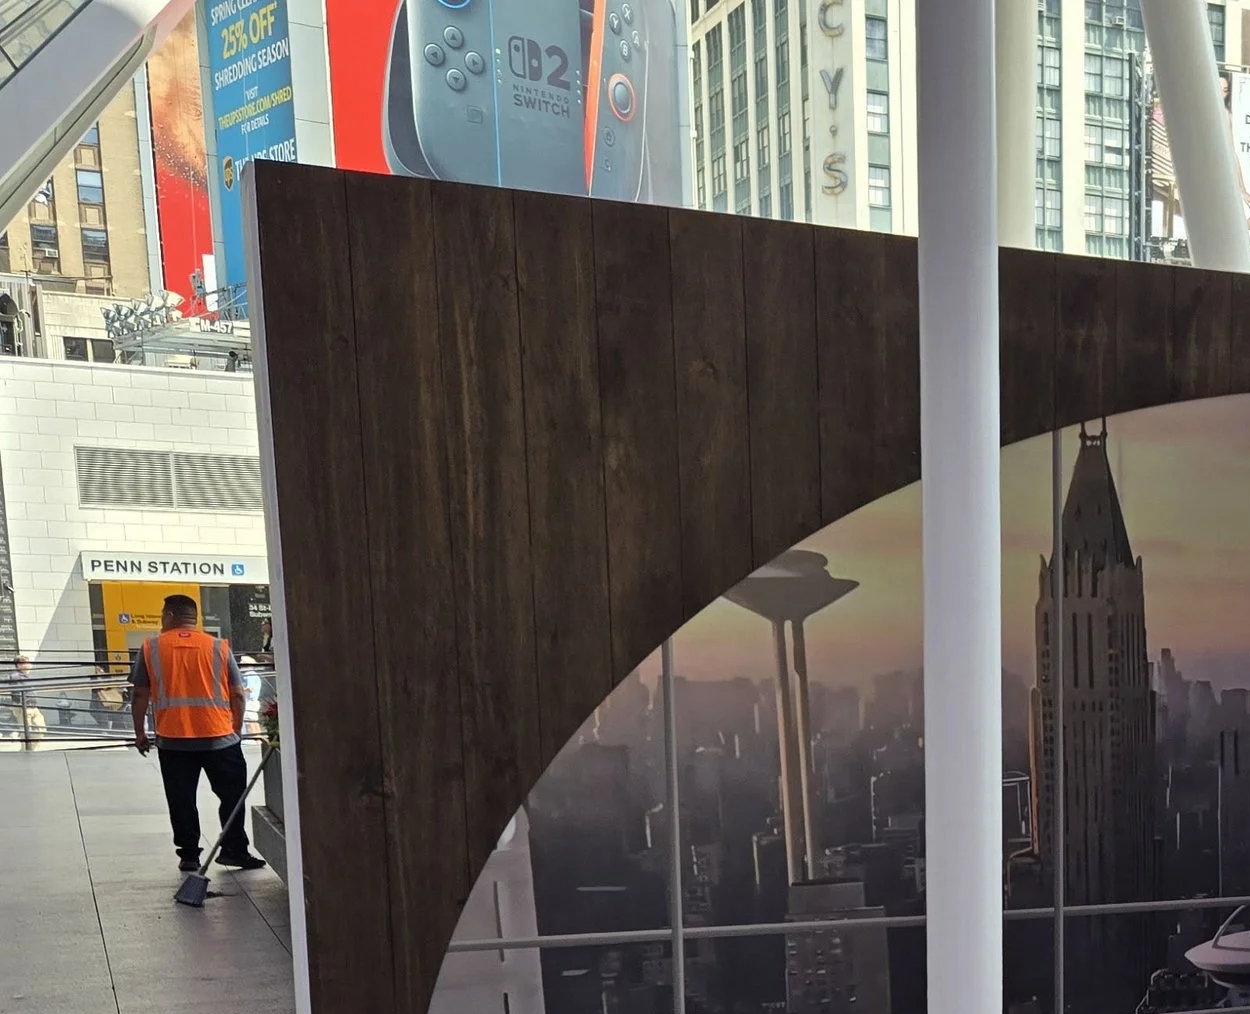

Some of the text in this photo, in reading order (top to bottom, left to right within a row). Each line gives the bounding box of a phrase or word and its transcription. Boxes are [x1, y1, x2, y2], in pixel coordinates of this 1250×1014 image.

[221, 19, 248, 60] 25%
[214, 38, 289, 91] SHREDDING SEASON
[544, 45, 571, 91] 2
[512, 83, 570, 105] NINTENDO
[512, 93, 571, 119] SWITCH
[269, 139, 297, 163] STORE
[91, 559, 225, 576] PENN STATION
